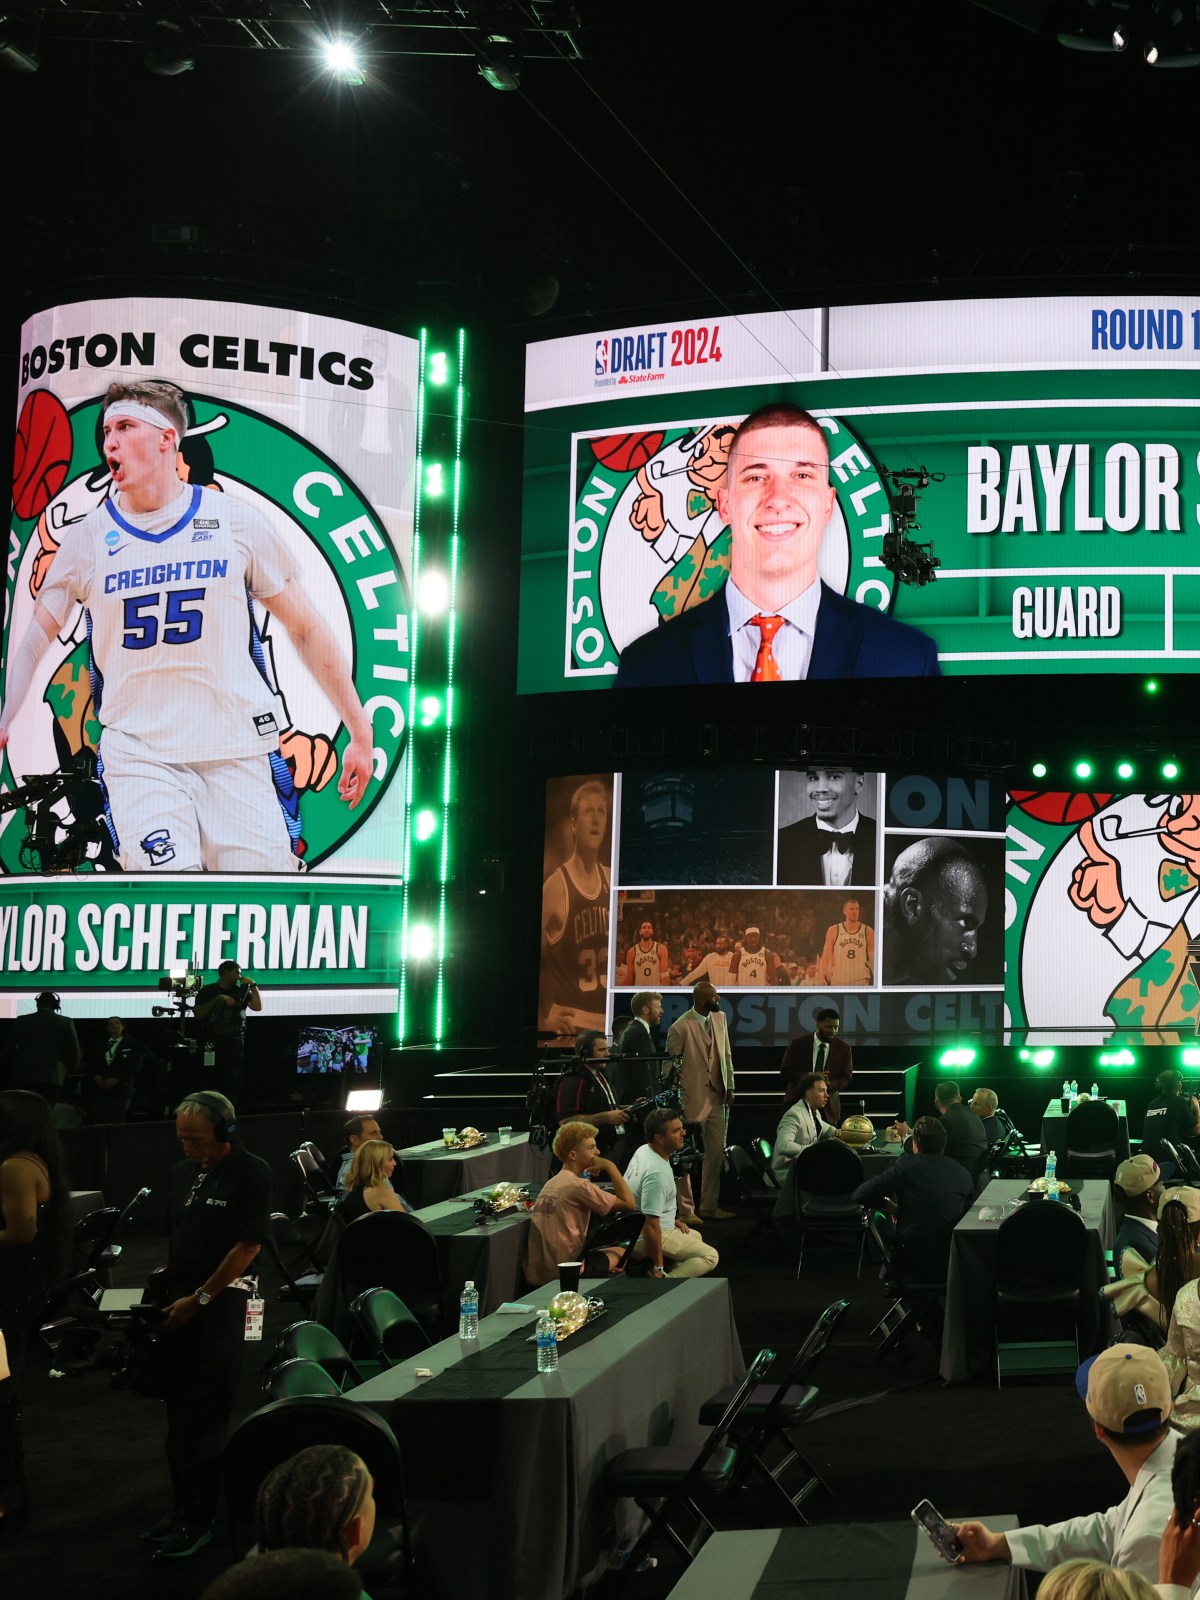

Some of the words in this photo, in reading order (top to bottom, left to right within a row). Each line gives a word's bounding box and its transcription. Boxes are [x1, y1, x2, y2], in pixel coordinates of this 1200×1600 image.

[1091, 309, 1183, 351] ROUND
[1190, 309, 1200, 350] 1
[21, 332, 155, 388] BOSTON
[180, 334, 375, 390] CELTICS
[611, 332, 667, 373] DRAFT
[671, 326, 722, 367] 2024
[966, 442, 1181, 535] BAYLOR
[104, 559, 228, 594] CREIGHTON
[121, 587, 206, 650] 55
[1012, 585, 1121, 639] GUARD
[75, 902, 369, 973] SCHEIERMAN
[839, 938, 864, 949] BOSTON
[636, 955, 658, 967] BOSTON
[742, 957, 765, 968] BOSTON
[846, 950, 856, 959] 8
[643, 967, 651, 977] 0
[749, 969, 758, 979] 4
[1146, 1107, 1168, 1116] ESPN
[205, 1197, 227, 1207] ESPN
